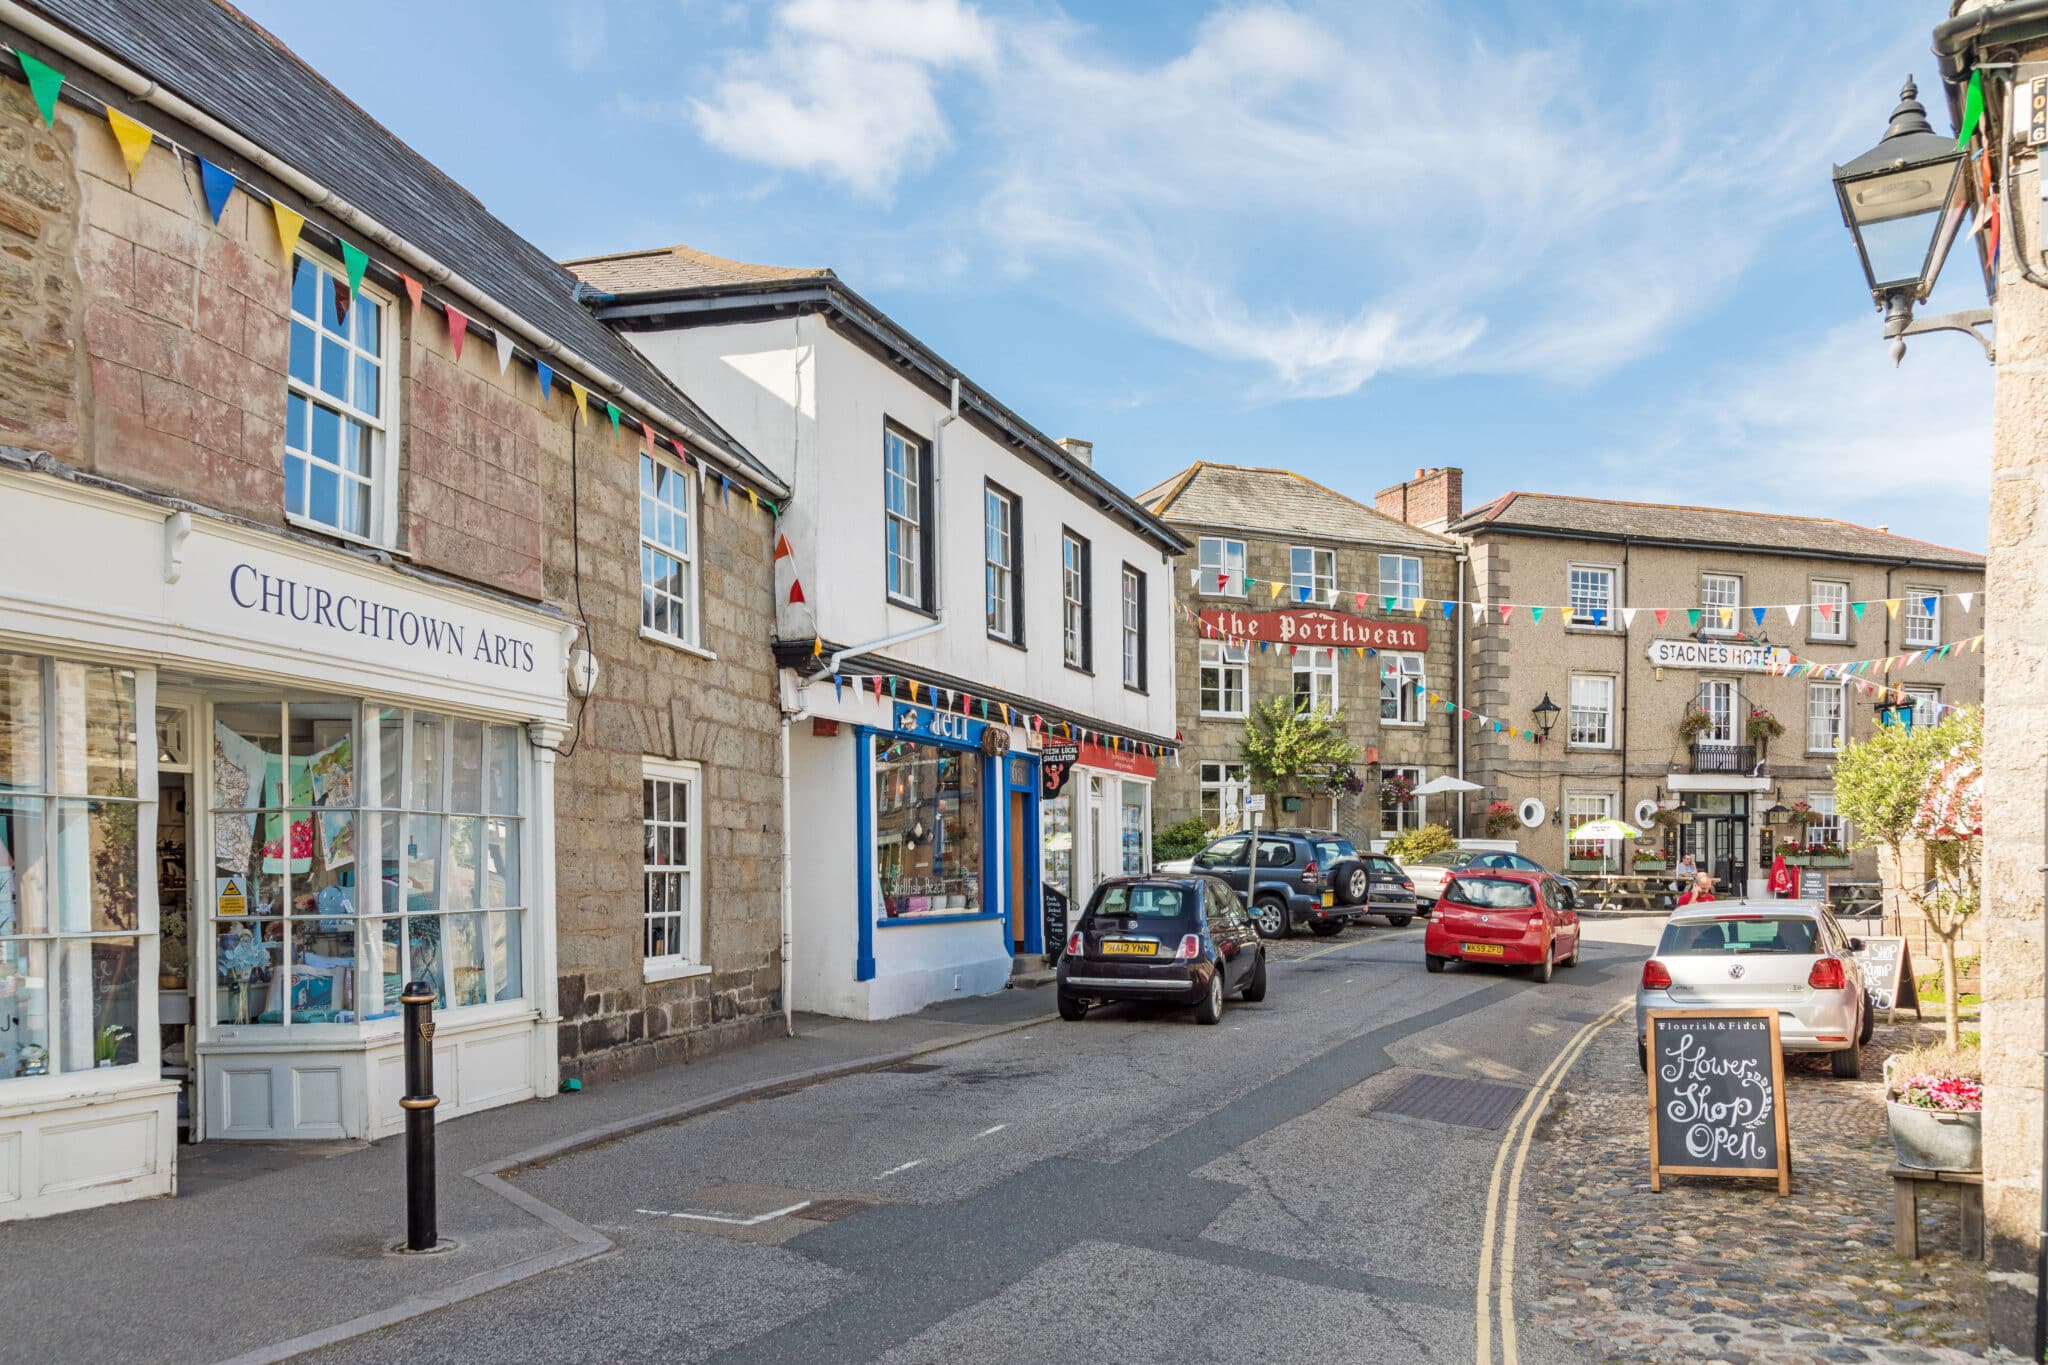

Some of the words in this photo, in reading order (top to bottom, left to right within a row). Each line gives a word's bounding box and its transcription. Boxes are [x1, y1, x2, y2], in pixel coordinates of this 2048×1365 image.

[230, 563, 464, 656] CHURCHTOWN
[473, 628, 534, 672] ARTS
[1218, 612, 1258, 636] the
[1279, 614, 1417, 646] Porthvean
[1661, 1033, 1757, 1082] Flower
[1667, 1082, 1752, 1128] Shop
[1685, 1123, 1766, 1161] Open
